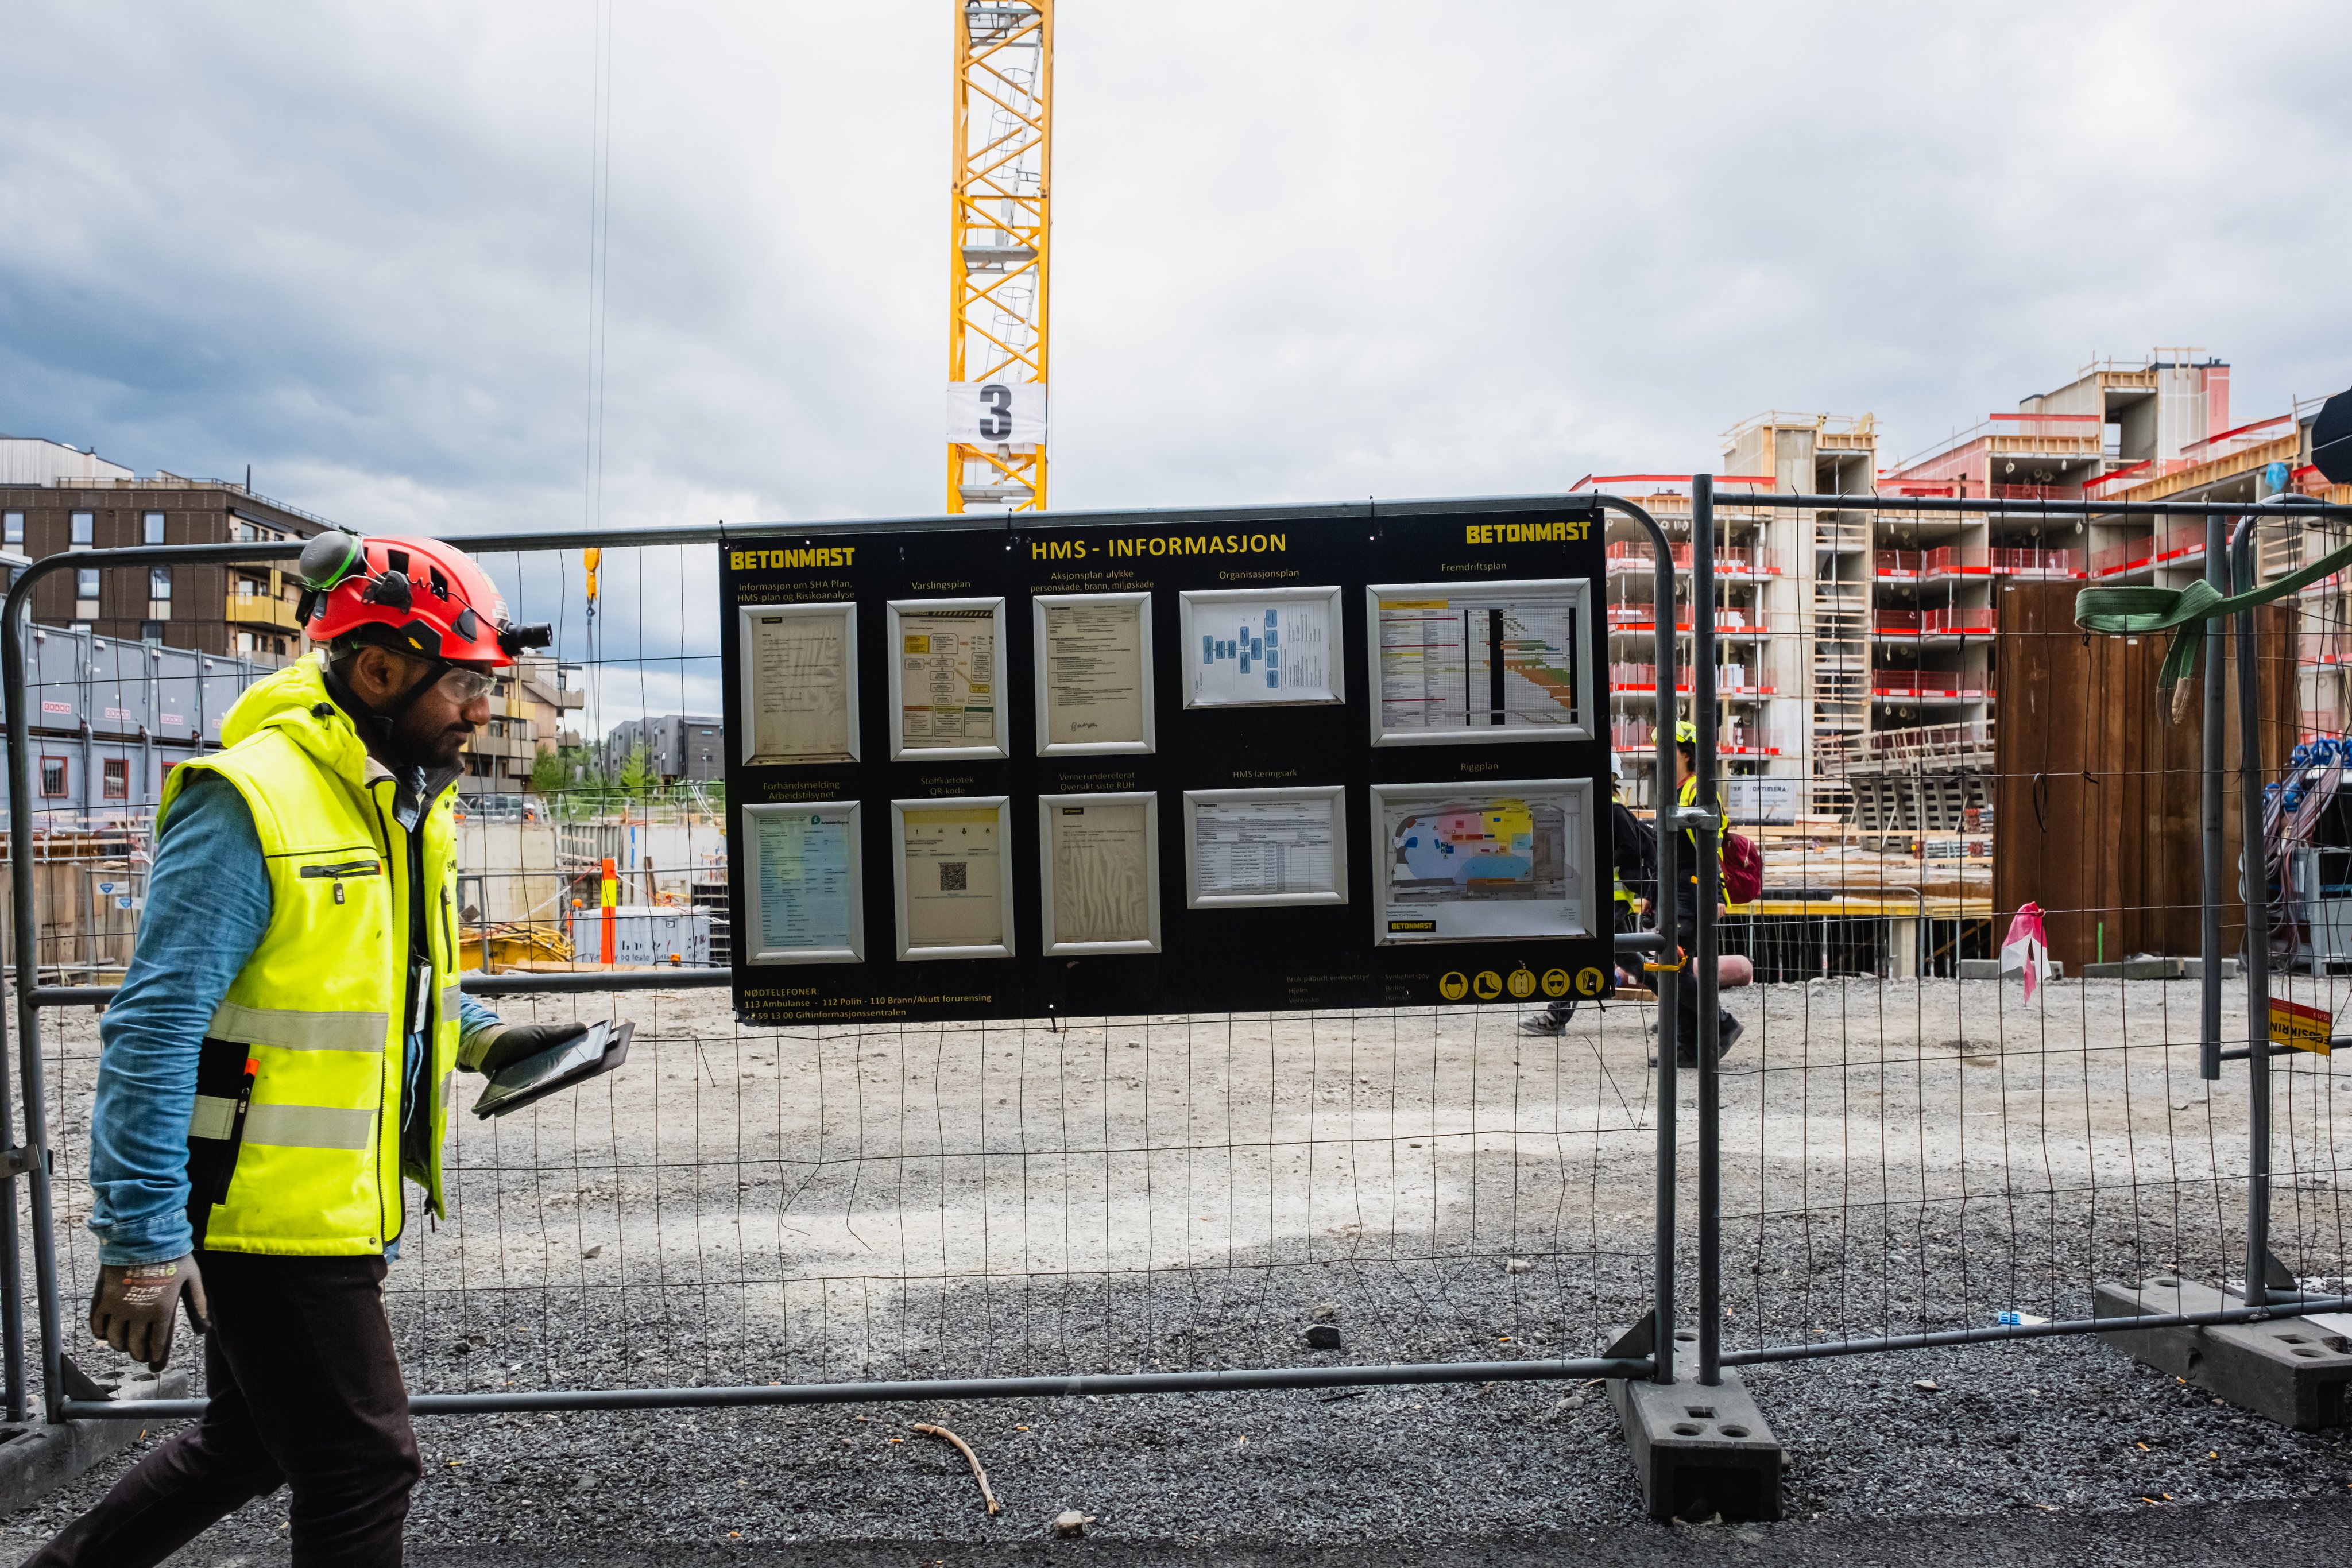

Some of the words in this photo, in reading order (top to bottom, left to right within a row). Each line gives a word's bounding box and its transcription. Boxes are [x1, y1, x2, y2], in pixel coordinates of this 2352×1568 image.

[980, 385, 1012, 441] 3
[1467, 521, 1591, 544] BETONMAST
[1032, 541, 1086, 560] HMS
[1109, 534, 1286, 557] INFORMASJON
[731, 547, 855, 570] BETONMAST
[1441, 562, 1506, 572] Fremdriftsplan
[1051, 571, 1103, 581] Aksjonsplan
[1106, 570, 1134, 579] ulykke
[1219, 569, 1299, 580] Organisasjonsplan
[739, 583, 790, 592] Informasjon
[810, 580, 828, 589] SHA
[831, 580, 853, 588] Plan,
[912, 580, 970, 590] Varslingsplan
[1031, 582, 1082, 593] personskade,
[1085, 582, 1109, 590] brann,
[1112, 580, 1154, 590] miljøskade
[738, 593, 780, 603] HMS-plan
[783, 594, 794, 602] og
[796, 591, 854, 600] Risikoanalyse
[1461, 762, 1498, 772] Riggplan
[1059, 772, 1135, 781] Vernerundereferat
[1255, 769, 1297, 778] læringsark
[921, 776, 974, 785] Stoffkartotek
[763, 781, 840, 791] Forhåndsmelding
[930, 787, 965, 795] QR-kode
[769, 791, 834, 800] Arbeidstilsynet
[888, 995, 939, 1004] Brann/Akutt
[942, 994, 992, 1002] forurensing
[796, 1009, 906, 1019] Giftinformasjonssentralen
[130, 1286, 166, 1295] Dry-Fit
